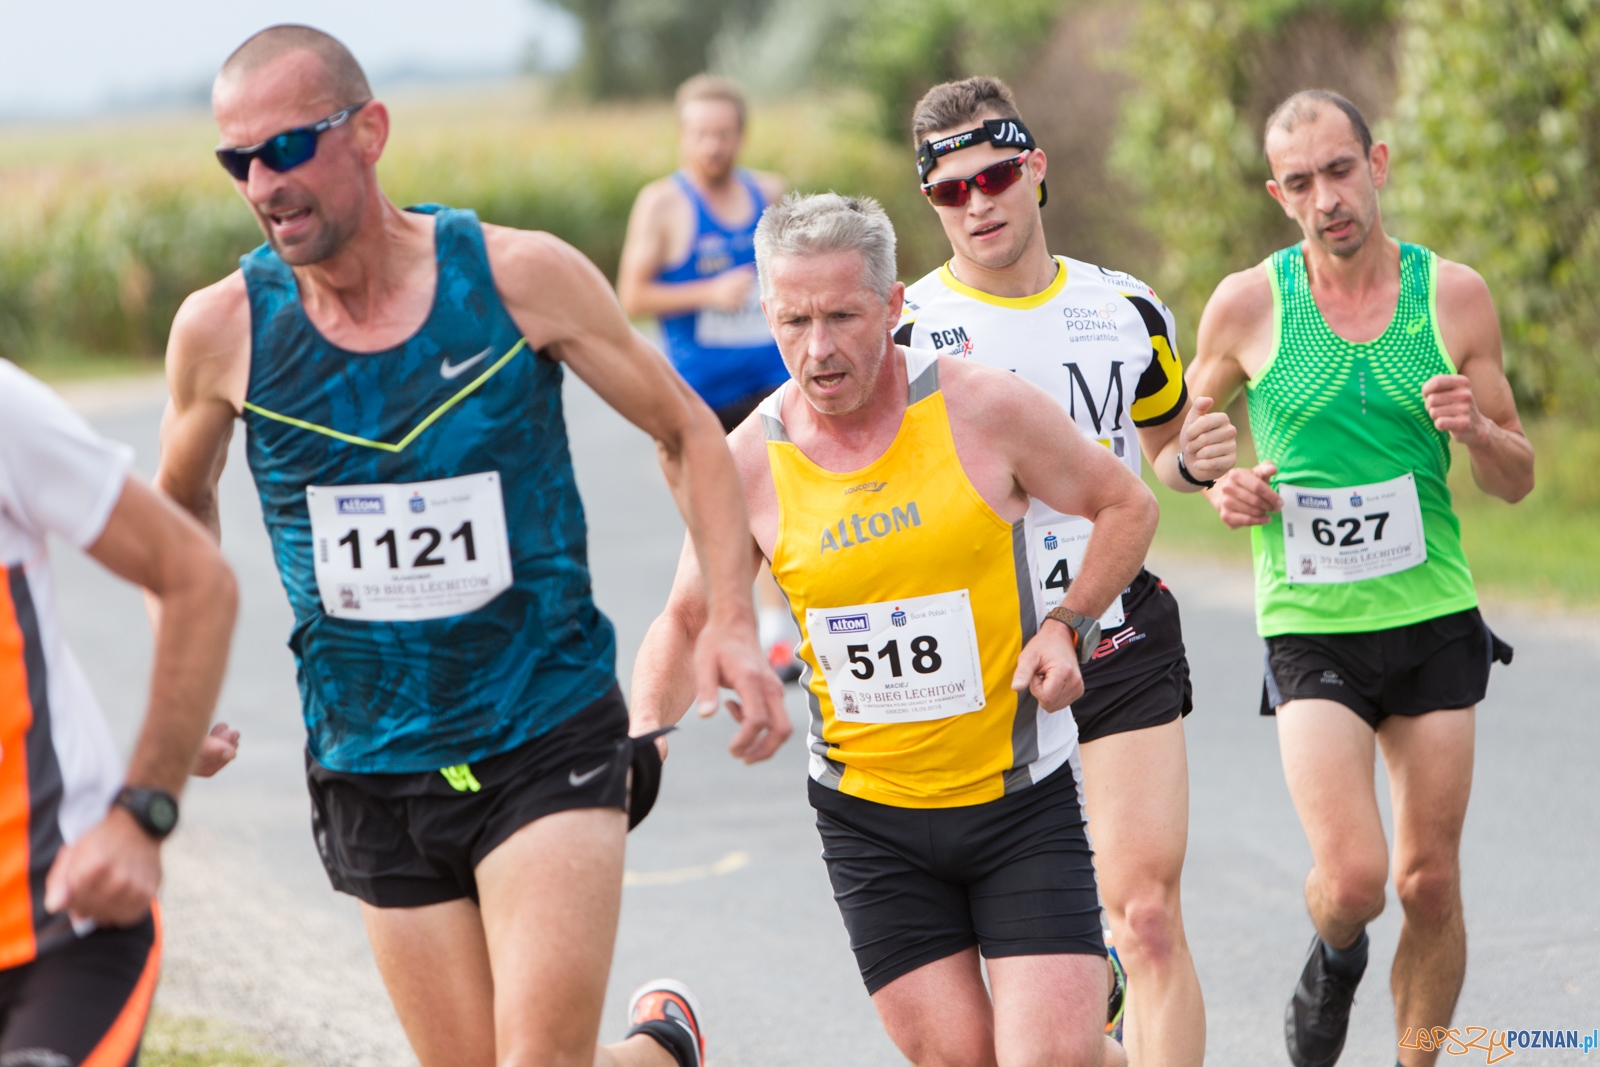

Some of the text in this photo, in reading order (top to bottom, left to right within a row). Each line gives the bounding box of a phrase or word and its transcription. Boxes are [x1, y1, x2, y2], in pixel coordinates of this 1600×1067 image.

[1101, 276, 1148, 292] Triathlon
[1063, 307, 1099, 318] OSSM
[1066, 318, 1118, 331] POZNAŃ
[930, 326, 969, 350] BCM
[1069, 333, 1120, 343] uamtriathlon
[843, 480, 878, 496] saucony
[1312, 511, 1390, 547] 627
[339, 521, 477, 569] 1121
[363, 583, 380, 596] 39
[383, 581, 416, 595] BIEG
[929, 609, 947, 617] Polski
[846, 635, 943, 681] 518
[859, 679, 967, 704] 39 BIEG LECHITÓW
[884, 682, 909, 690] MACIEJ
